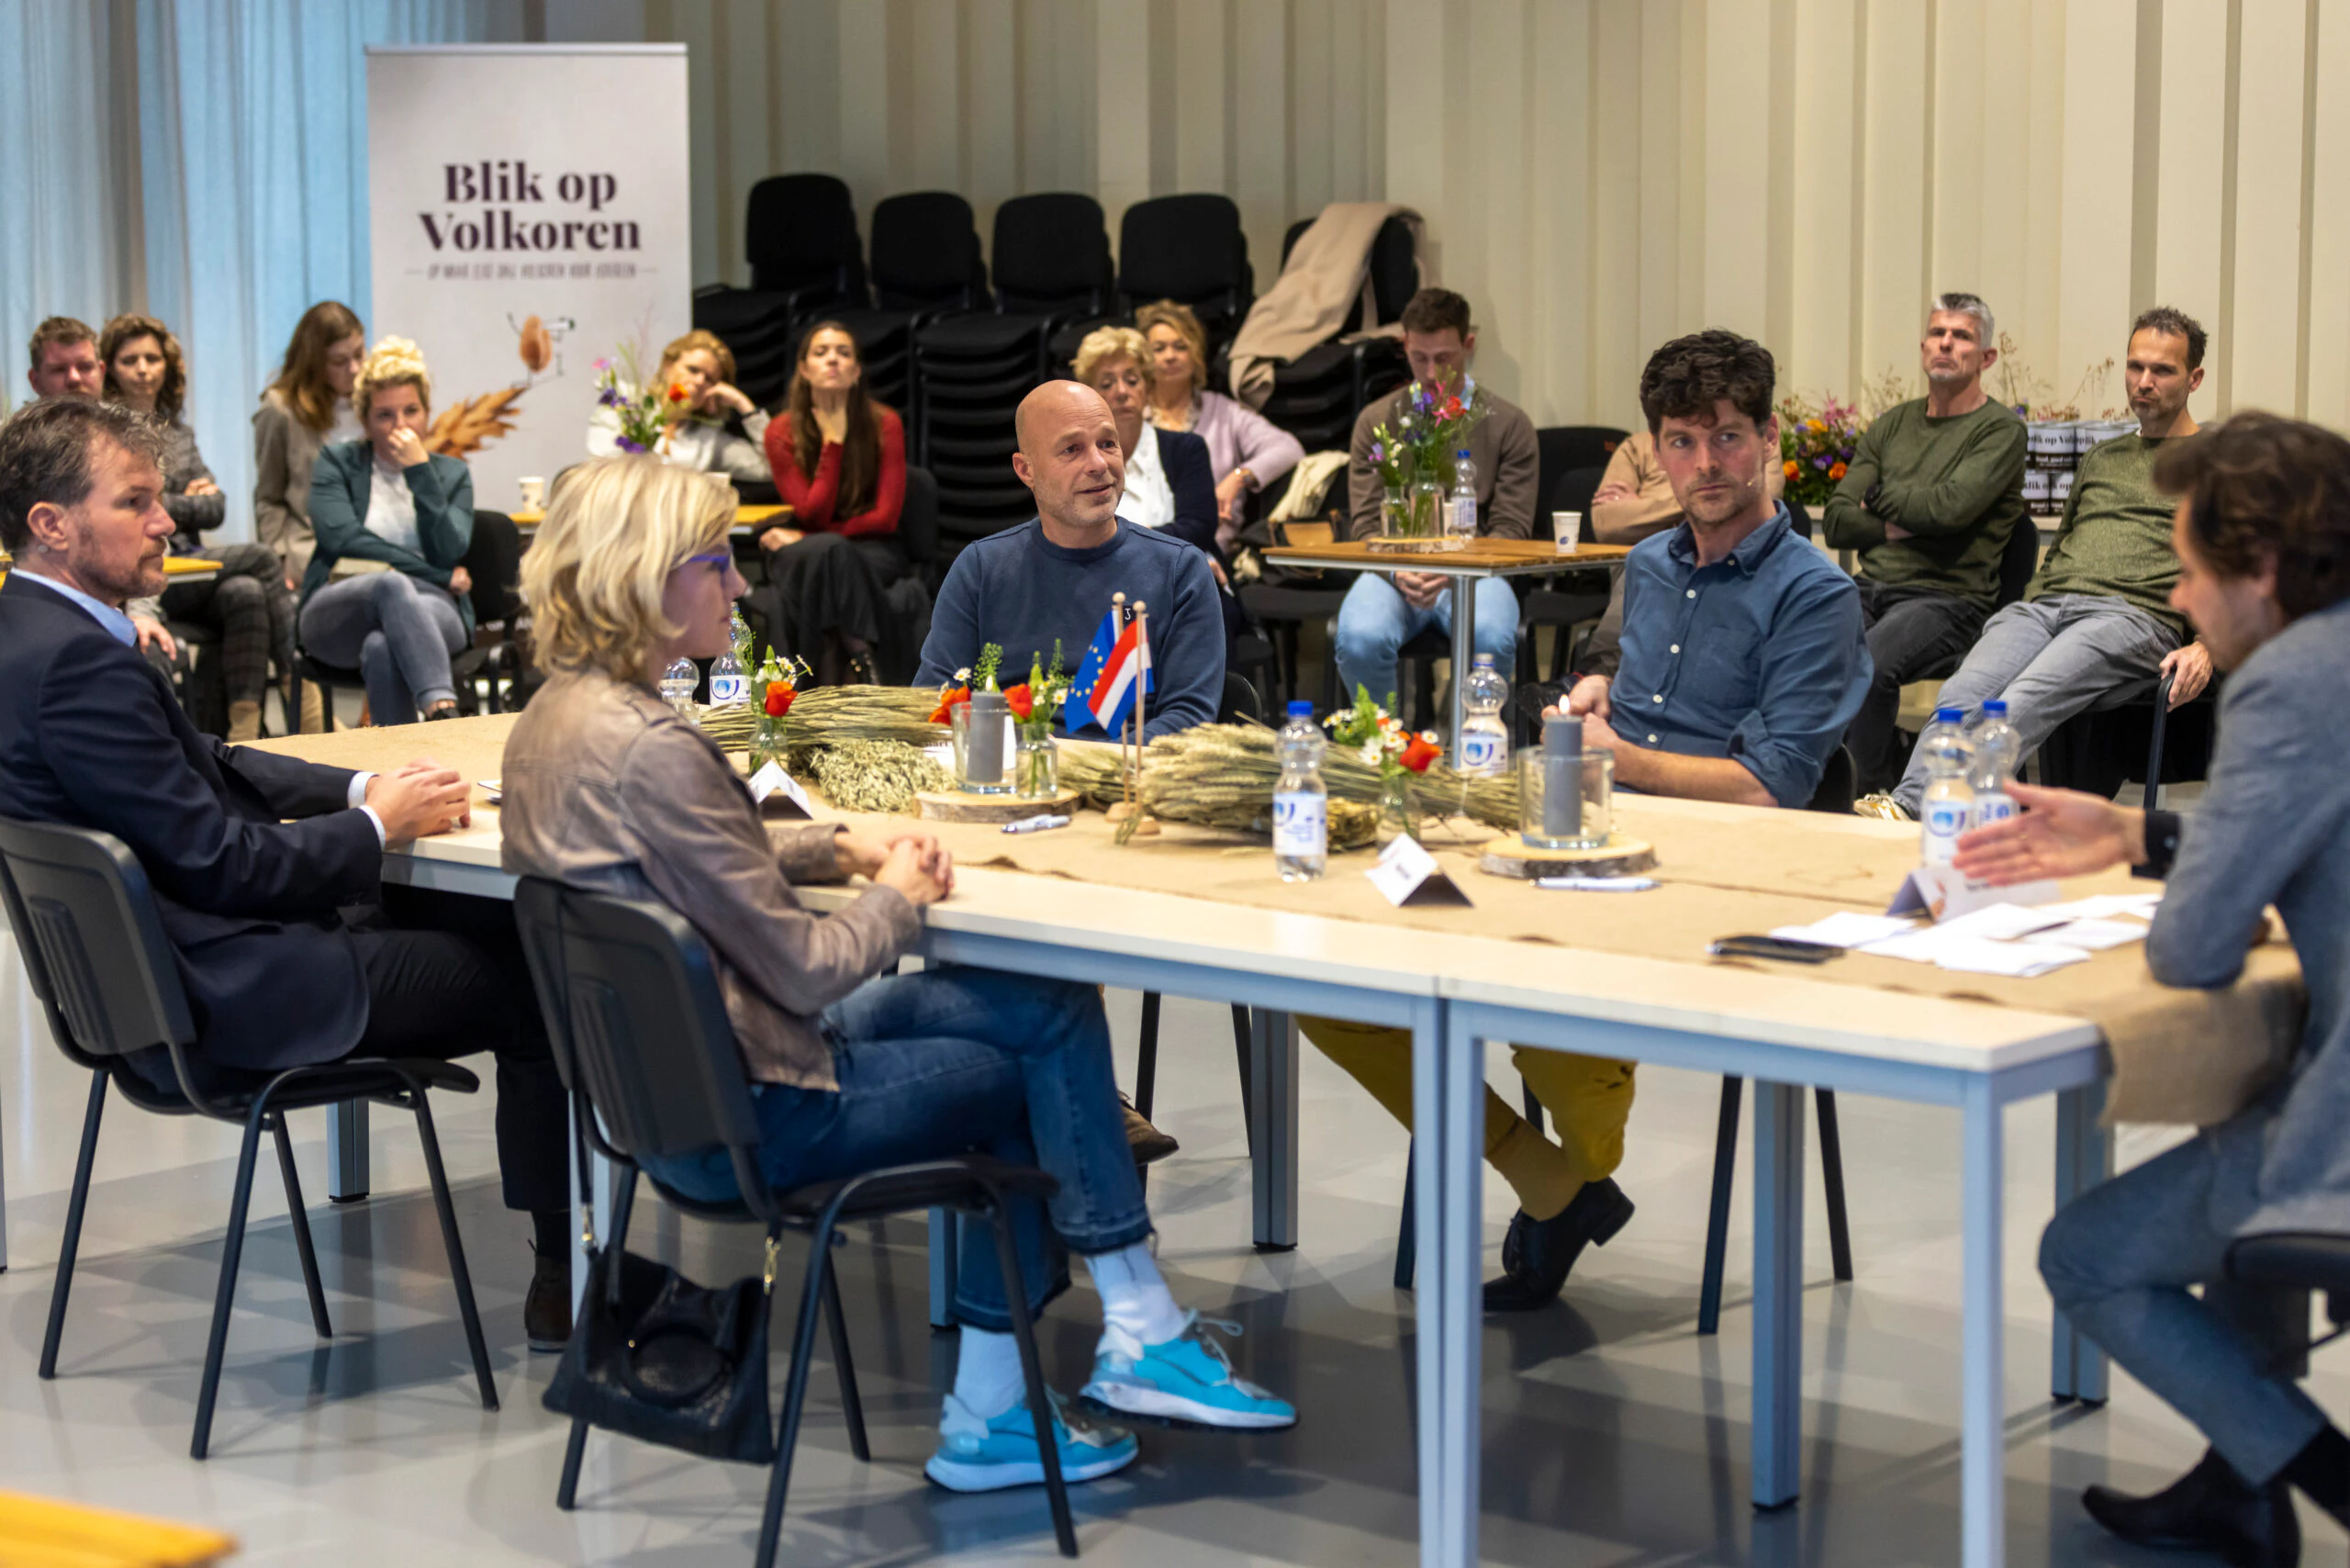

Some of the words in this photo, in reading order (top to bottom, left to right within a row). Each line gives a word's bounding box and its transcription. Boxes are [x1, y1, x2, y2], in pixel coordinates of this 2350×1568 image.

[444, 161, 543, 204] Blik
[557, 172, 618, 212] op
[419, 209, 642, 252] Volkoren
